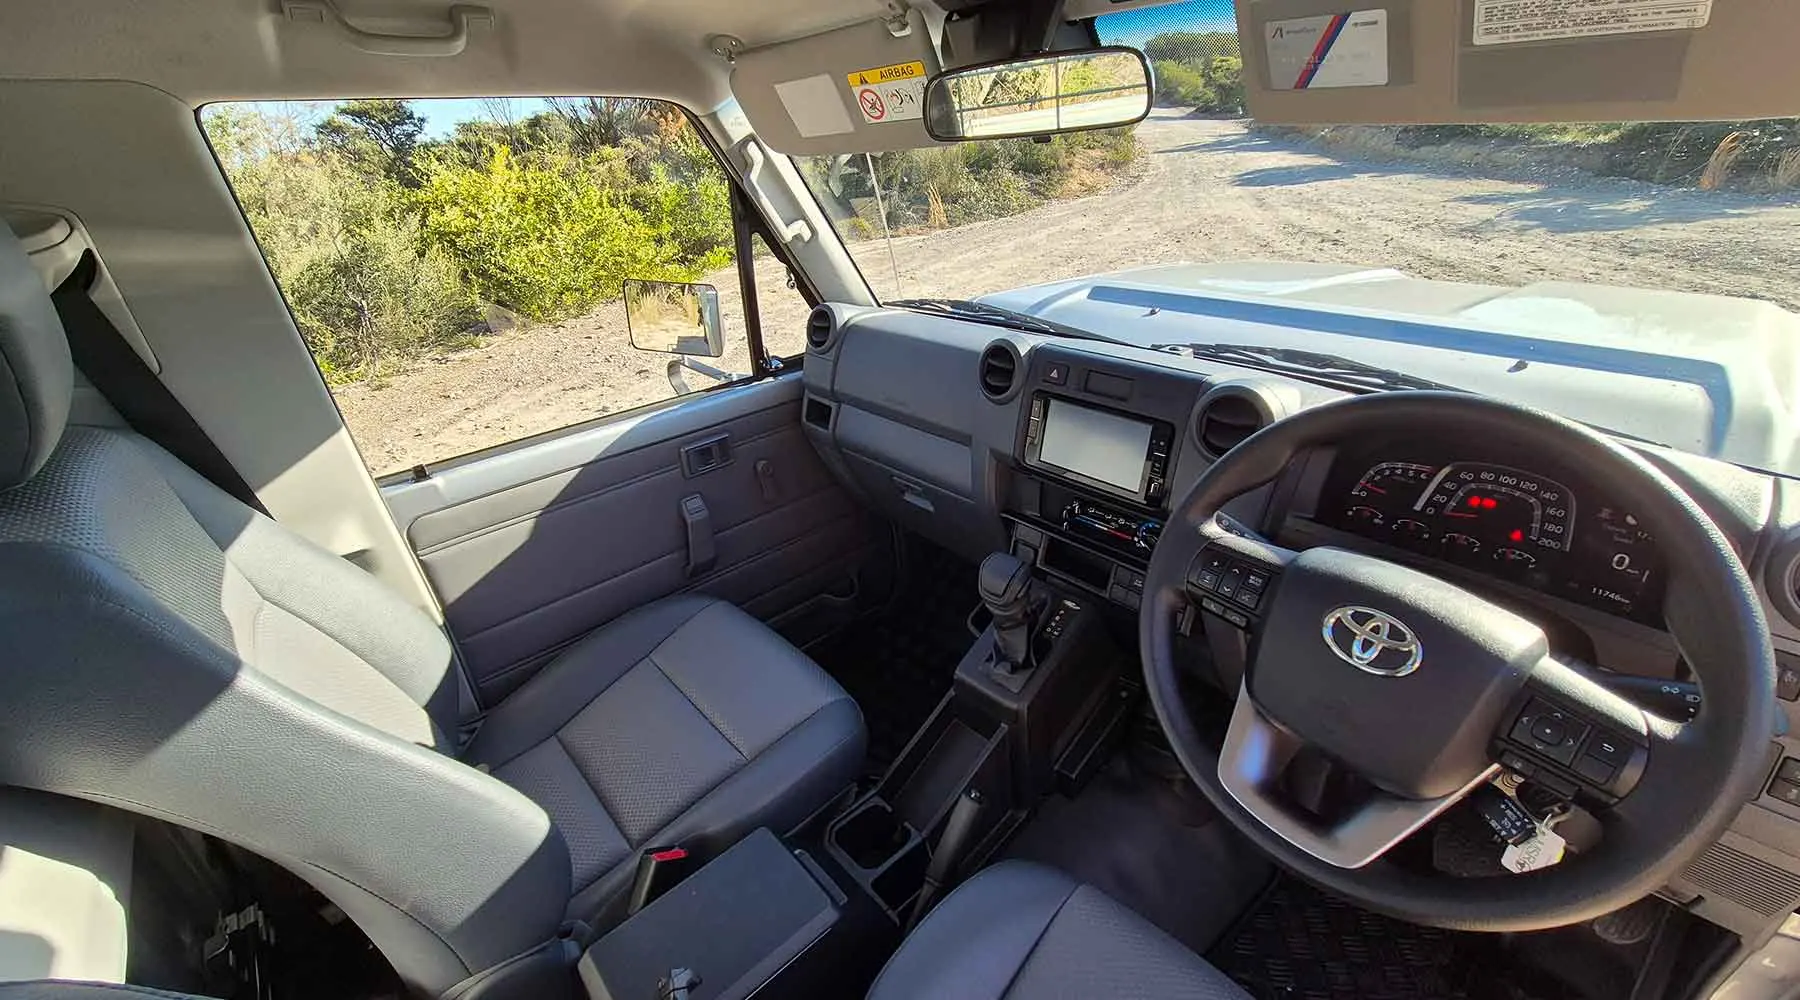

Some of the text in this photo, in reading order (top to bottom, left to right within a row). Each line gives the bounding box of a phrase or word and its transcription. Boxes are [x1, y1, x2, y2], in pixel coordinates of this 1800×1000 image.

[879, 65, 915, 81] AIRBAG
[1426, 471, 1566, 550] 0 20 40 60 80 100 120 140 160 180 200
[1612, 553, 1630, 570] 0
